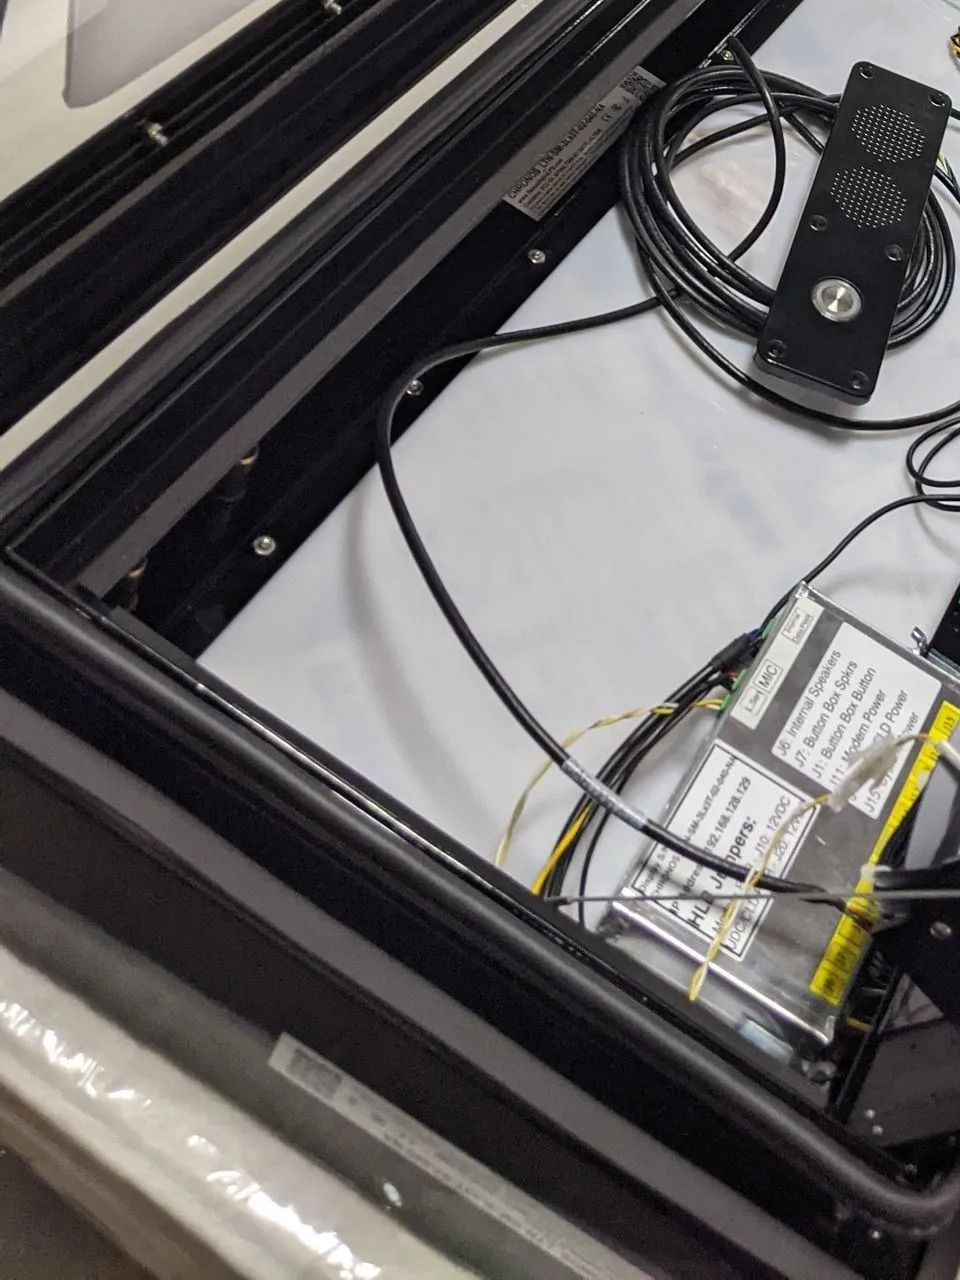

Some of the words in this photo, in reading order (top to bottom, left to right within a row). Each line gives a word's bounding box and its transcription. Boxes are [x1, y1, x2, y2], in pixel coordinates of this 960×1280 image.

[758, 663, 778, 688] MIC
[774, 735, 793, 757] J6:
[784, 694, 815, 738] Internal
[806, 647, 843, 698] Speakers
[792, 747, 810, 768] J7:
[802, 710, 829, 748] Button
[822, 688, 842, 713] Box
[834, 658, 858, 692] Spkrs
[884, 688, 910, 724] Power
[809, 757, 828, 779] J1:
[819, 721, 846, 759] Button
[838, 698, 859, 723] Box
[850, 665, 877, 701] Button
[840, 720, 870, 765] Modem
[862, 688, 887, 723] Power
[703, 775, 753, 852] 192.168.128.129
[765, 794, 792, 832] 12VDC
